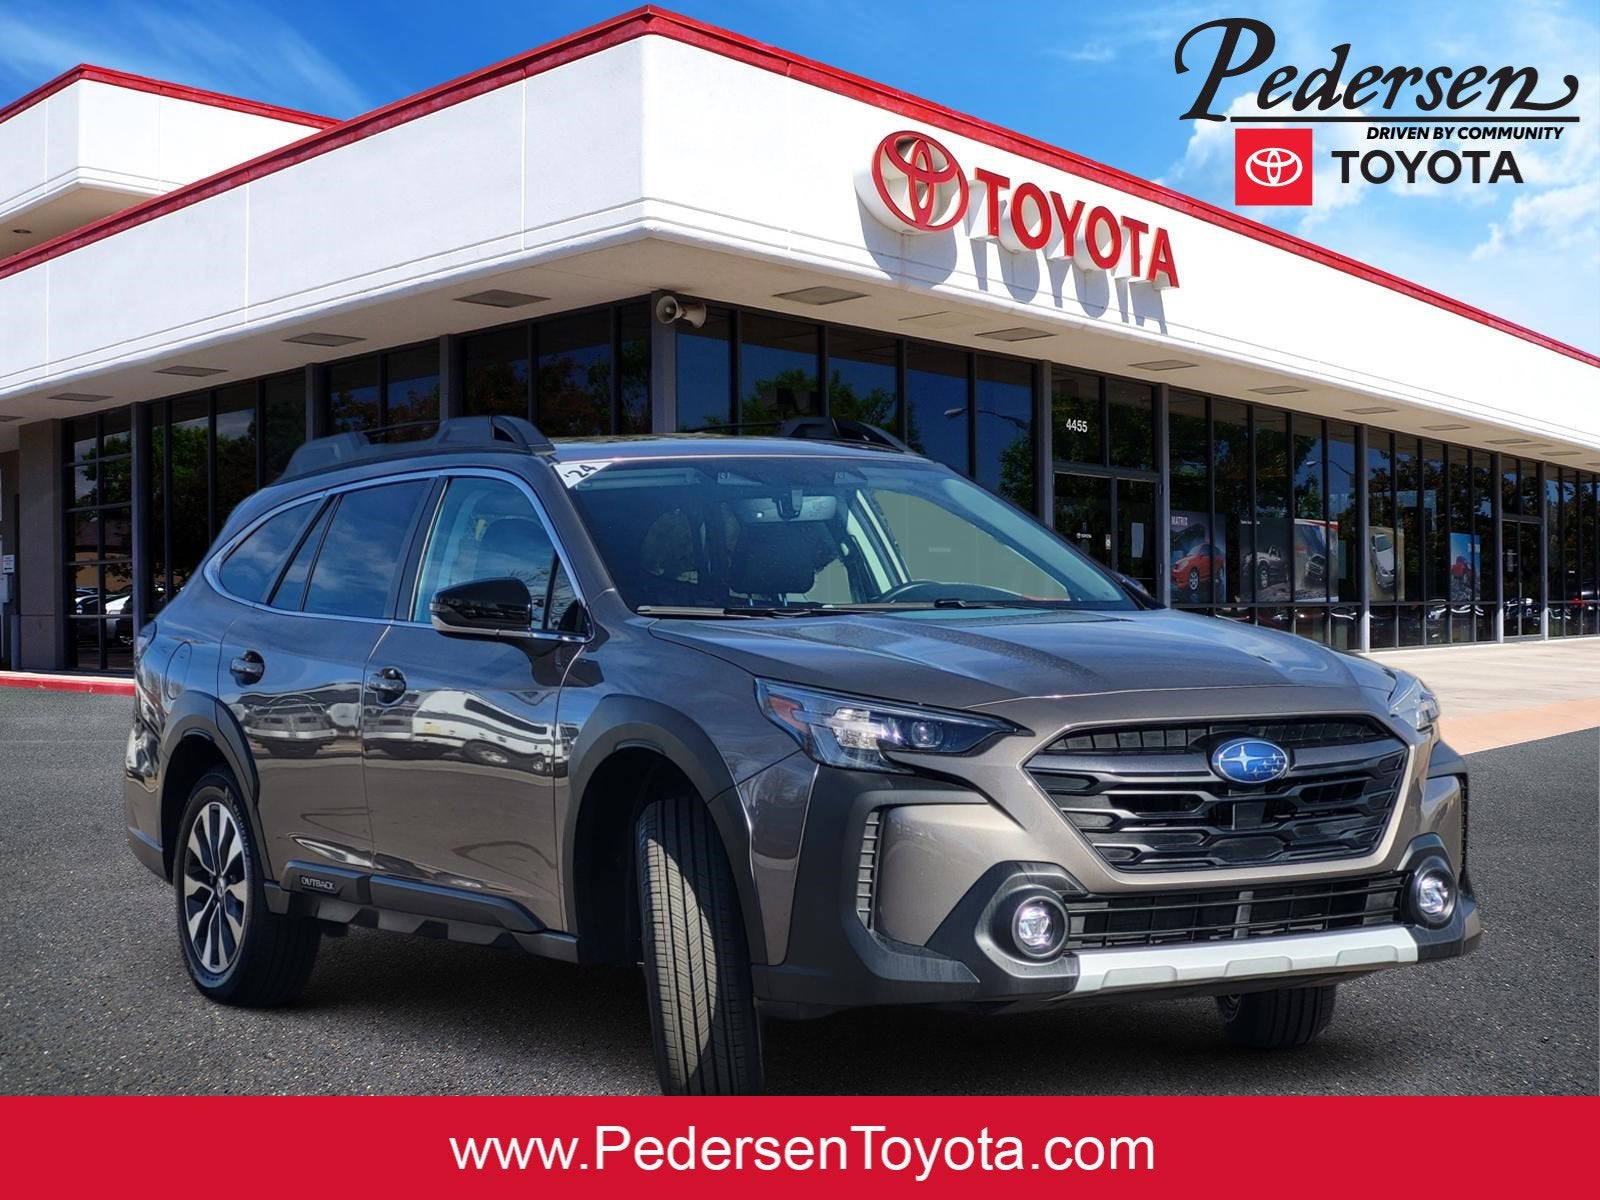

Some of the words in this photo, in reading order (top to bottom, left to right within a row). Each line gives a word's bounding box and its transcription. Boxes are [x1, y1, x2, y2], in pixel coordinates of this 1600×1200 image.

[975, 167, 1180, 288] TOYOTA
[1065, 418, 1088, 433] 4455
[301, 876, 335, 890] OUTBACK
